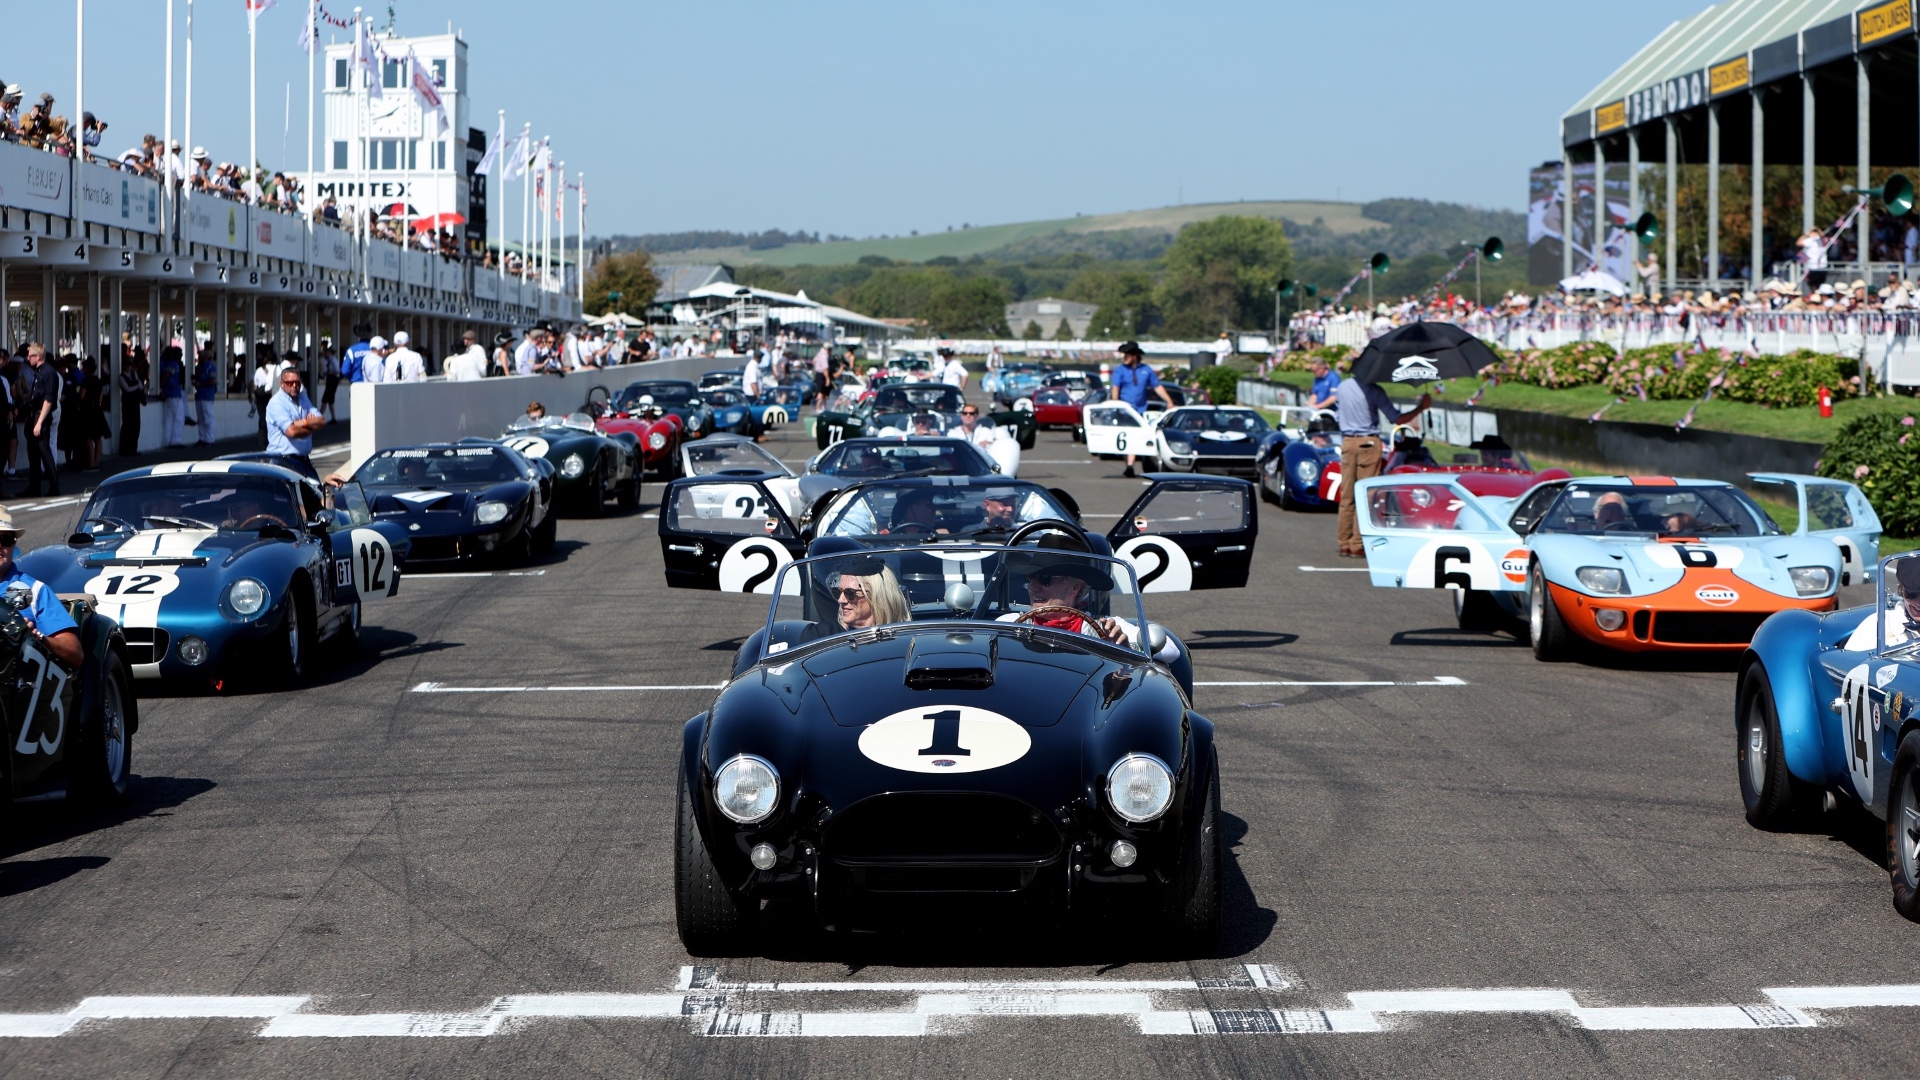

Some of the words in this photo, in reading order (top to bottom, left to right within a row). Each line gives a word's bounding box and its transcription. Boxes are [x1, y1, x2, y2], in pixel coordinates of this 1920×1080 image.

[1863, 12, 1886, 36] CLUTCH
[1887, 3, 1908, 28] LINERS
[1632, 72, 1701, 125] FERODO
[317, 182, 412, 197] MINTEX
[23, 236, 33, 252] 3
[75, 244, 85, 259] 4
[122, 252, 131, 266] 5
[163, 258, 172, 271] 6
[218, 267, 226, 279] 7
[250, 272, 258, 284] 8
[280, 277, 288, 288] 9
[300, 281, 314, 292] 10
[378, 294, 389, 304] 14
[397, 297, 409, 306] 15
[414, 300, 425, 309] 16
[430, 302, 441, 311] 17
[445, 304, 456, 313] 18
[767, 412, 785, 424] 40
[828, 425, 843, 445] 77
[1116, 432, 1127, 450] 6
[1672, 545, 1718, 568] 6
[337, 561, 350, 584] GT
[360, 541, 385, 593] 12
[741, 544, 778, 593] 2
[1130, 543, 1170, 593] 2
[1434, 545, 1472, 591] 6
[105, 575, 162, 595] 12
[15, 643, 68, 756] 23
[918, 710, 971, 756] 1
[1844, 678, 1869, 779] 14
